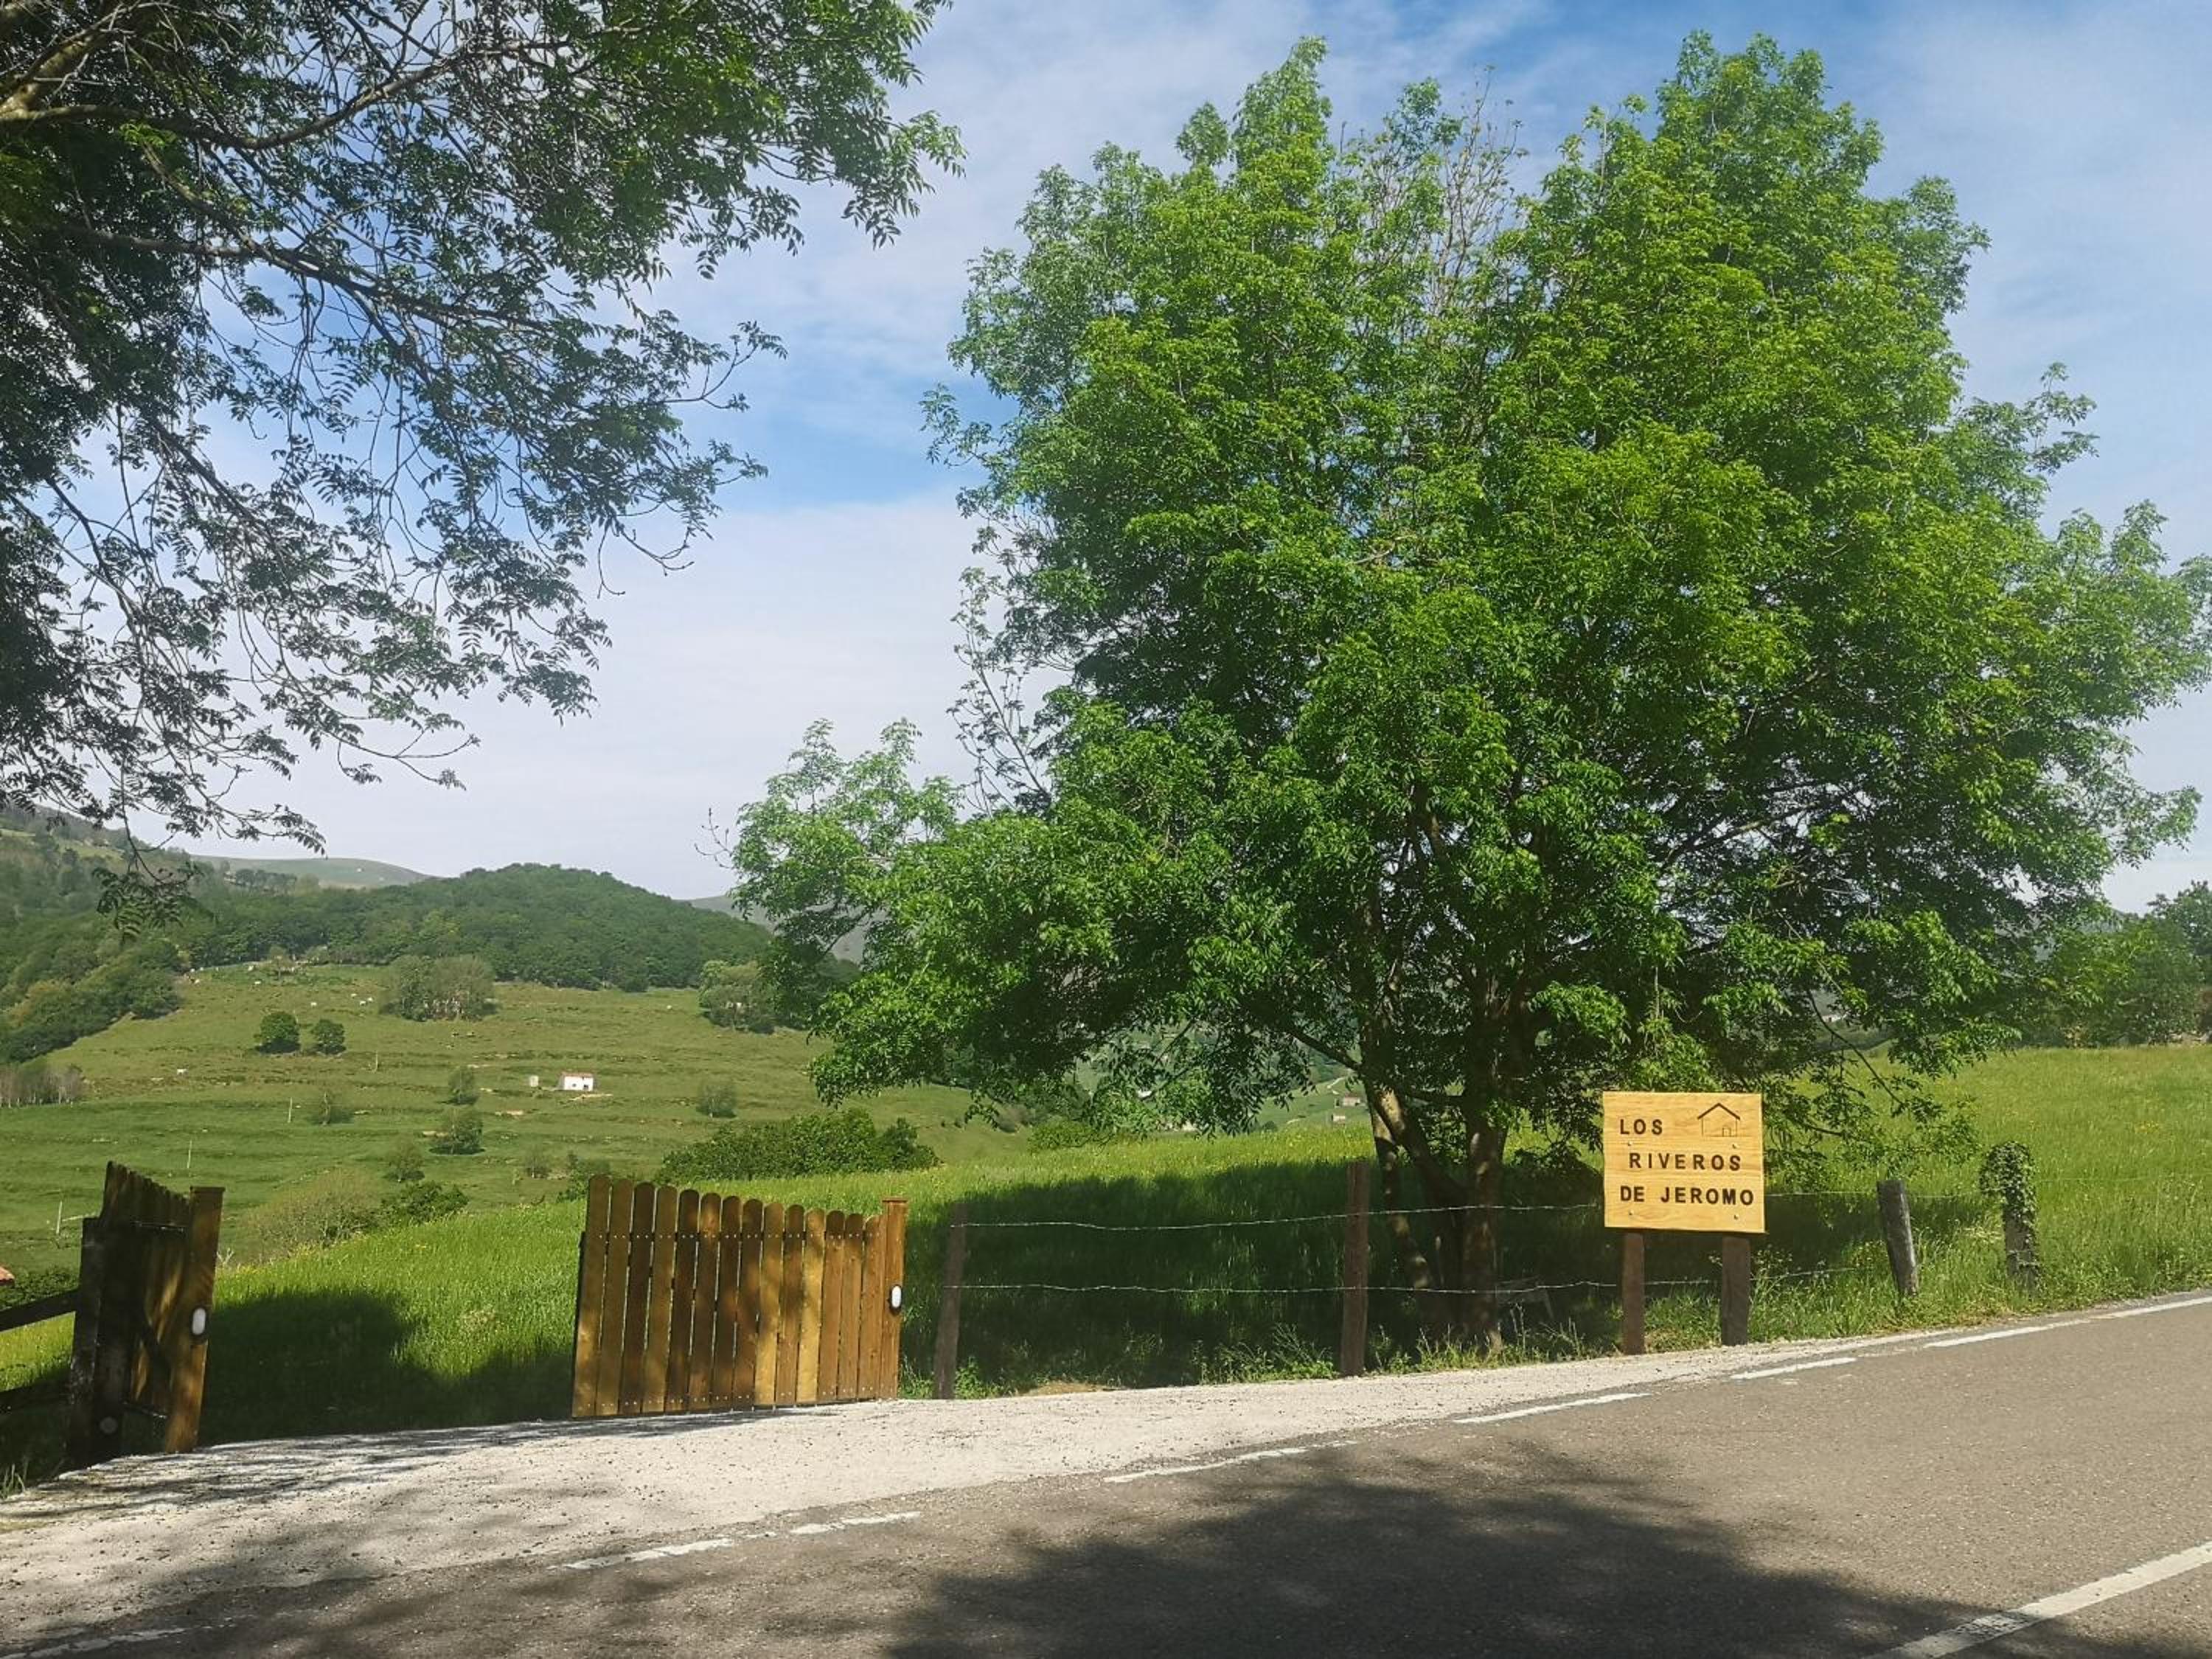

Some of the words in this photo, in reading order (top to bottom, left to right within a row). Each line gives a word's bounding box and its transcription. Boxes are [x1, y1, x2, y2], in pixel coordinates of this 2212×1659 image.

[1620, 1119, 1663, 1135] LOS
[1629, 1152, 1741, 1171] RIVEROS
[1620, 1185, 1645, 1203] DE
[1660, 1186, 1754, 1206] JEROMO
